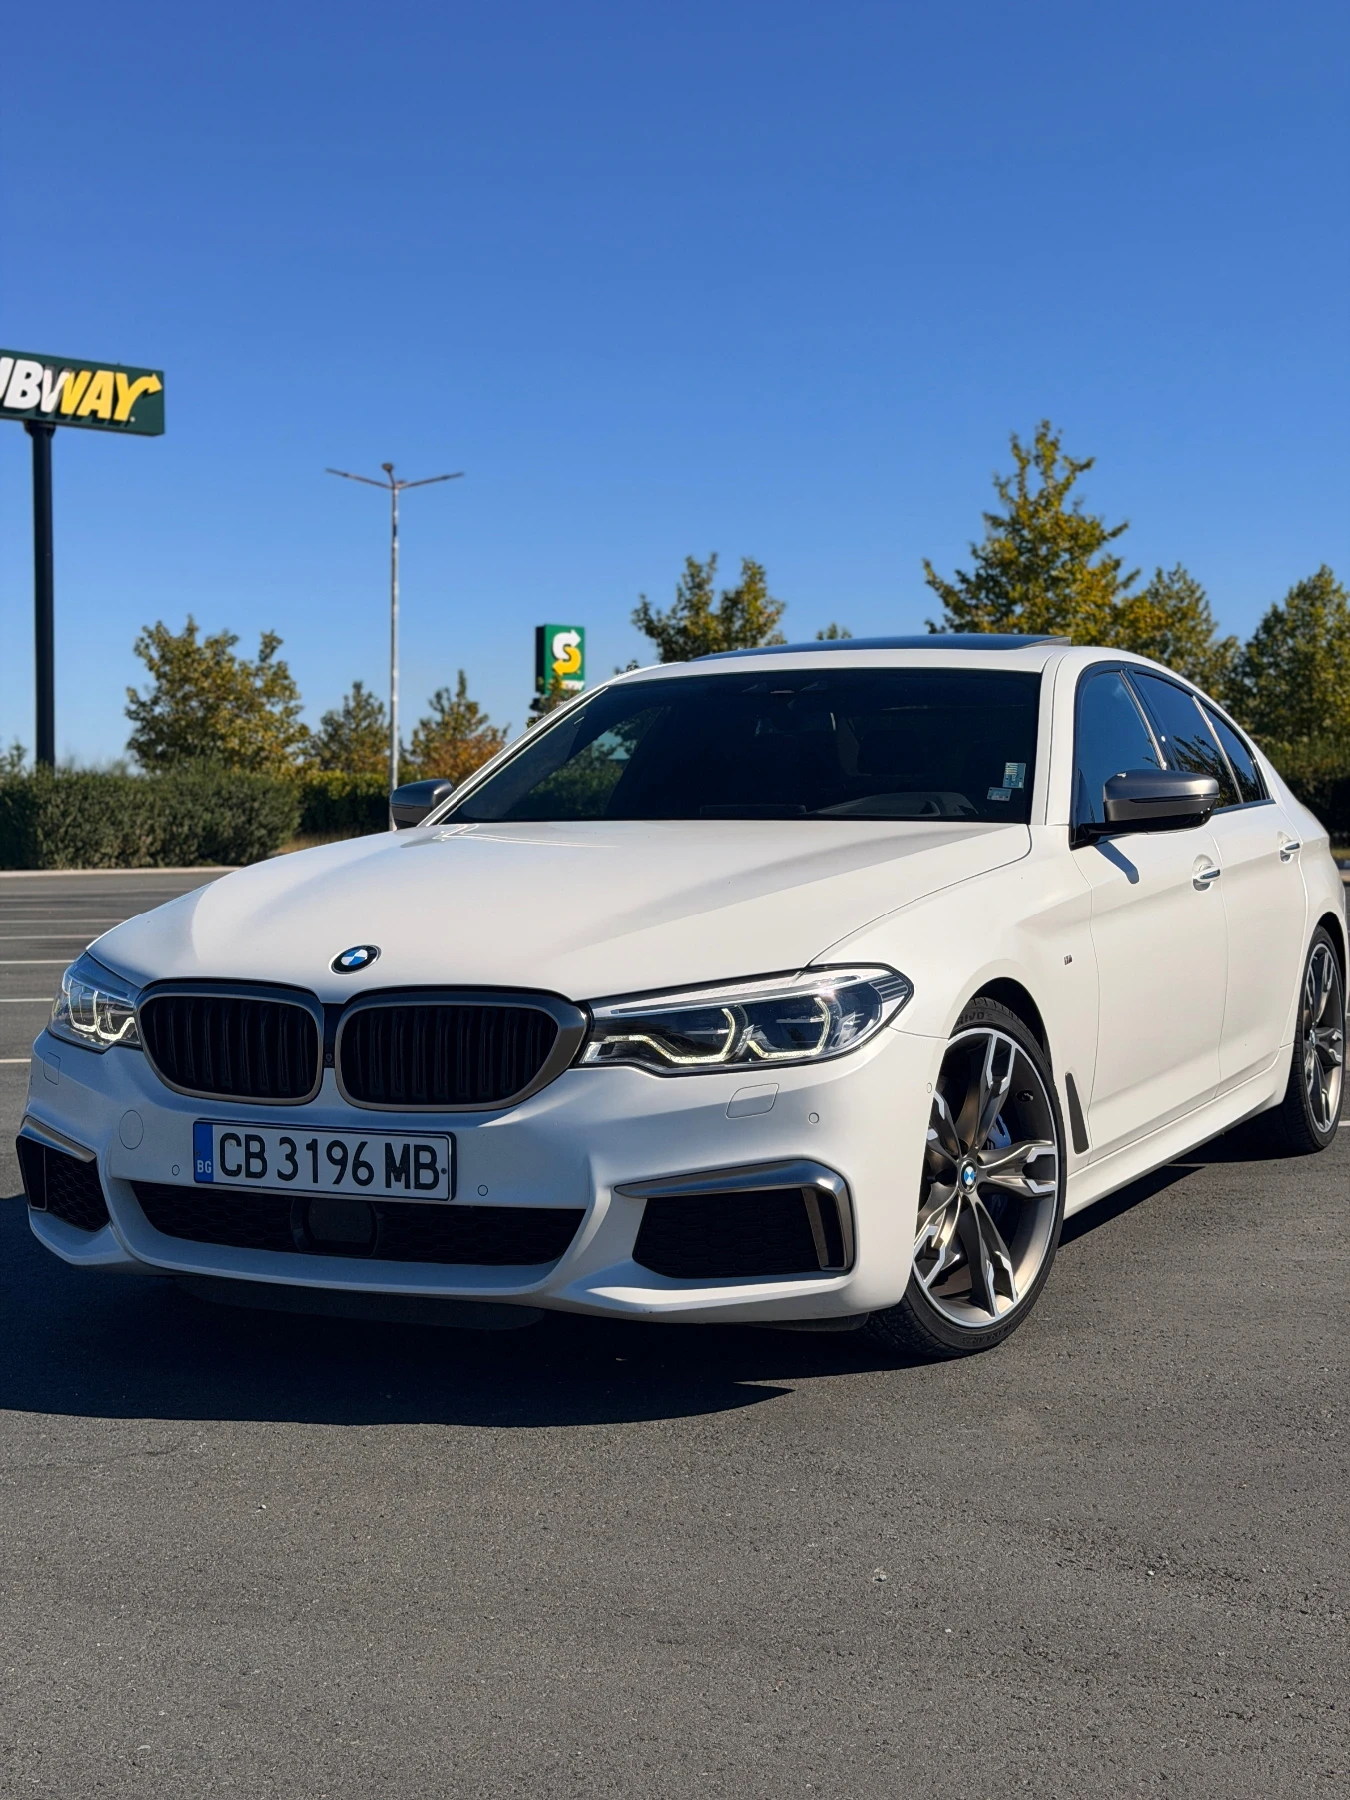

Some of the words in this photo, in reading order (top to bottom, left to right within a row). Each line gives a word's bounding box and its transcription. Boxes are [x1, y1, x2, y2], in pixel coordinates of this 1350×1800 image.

[197, 1160, 212, 1173] BG
[219, 1133, 268, 1179] CB
[277, 1136, 375, 1187] 3196
[384, 1142, 440, 1190] MB
